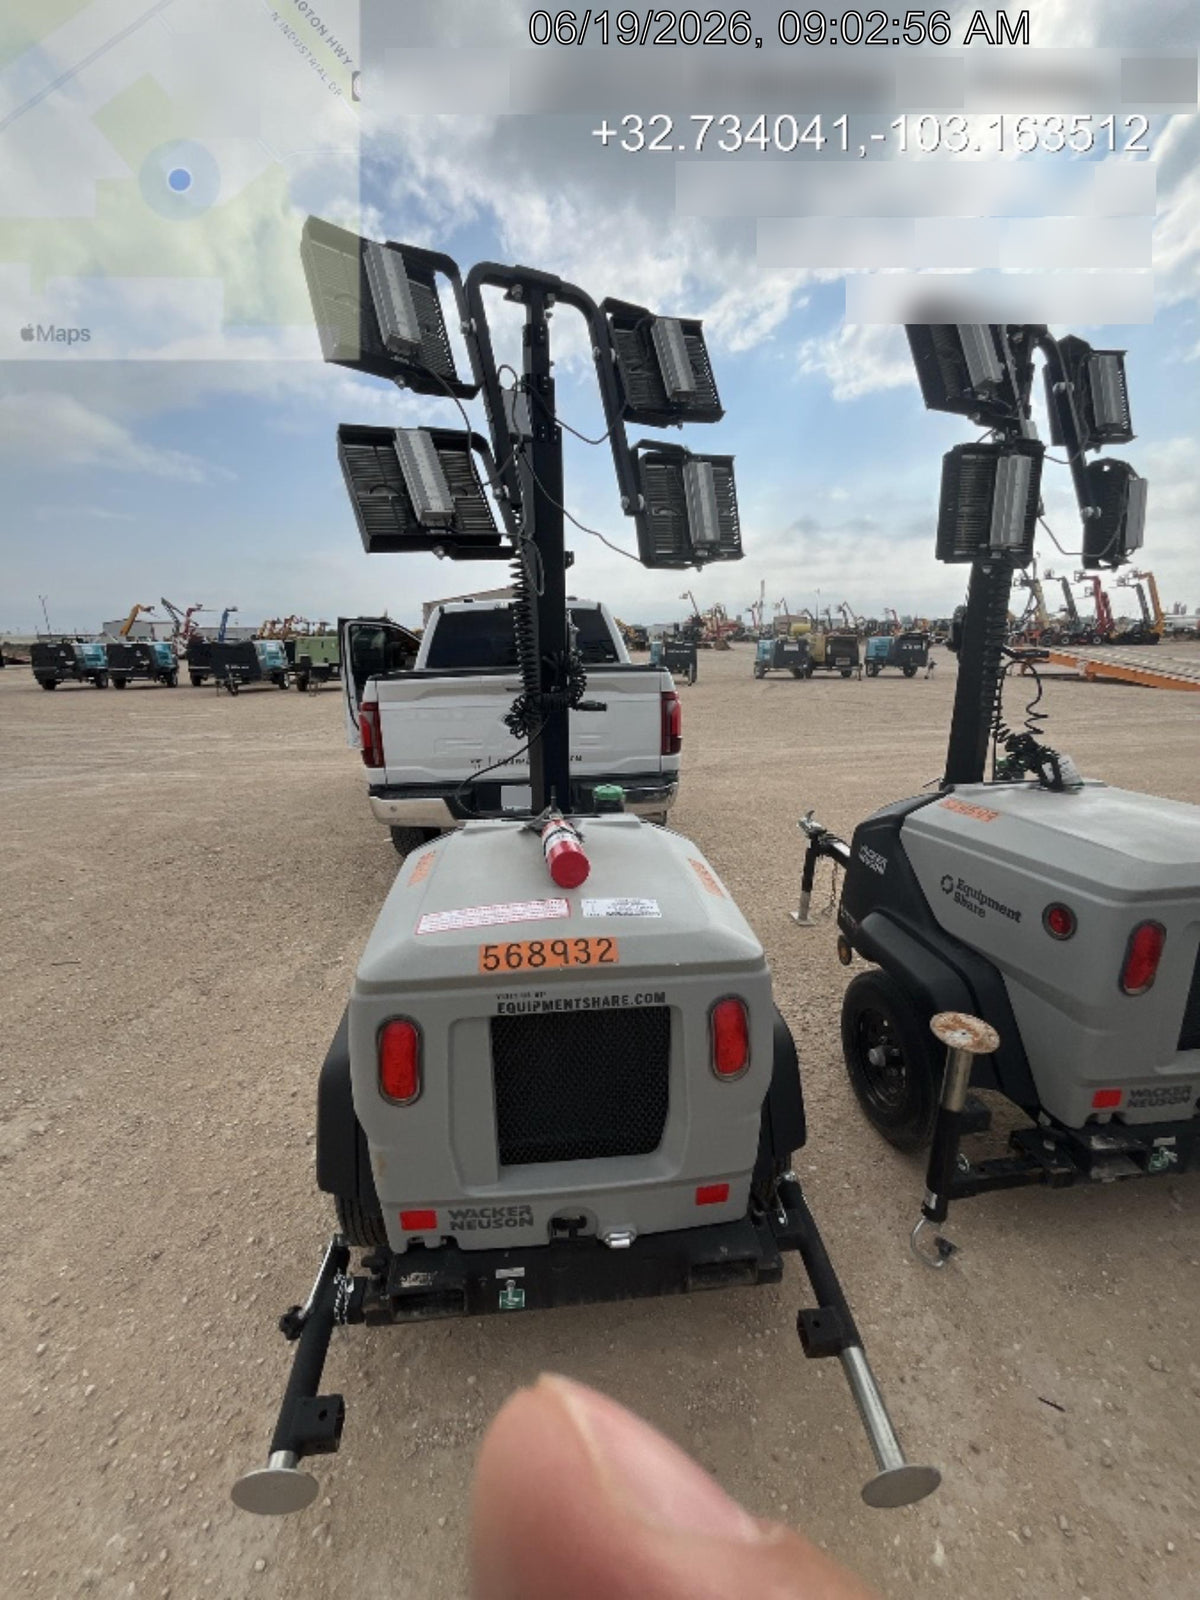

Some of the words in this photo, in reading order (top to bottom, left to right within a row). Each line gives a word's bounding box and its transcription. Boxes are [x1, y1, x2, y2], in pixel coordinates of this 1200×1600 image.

[953, 890, 986, 919] Share
[956, 877, 1022, 924] Equipment
[482, 937, 615, 971] 568932
[497, 992, 666, 1014] EQUIPMENTSHARE.COM
[447, 1205, 532, 1220] WACKER
[449, 1217, 534, 1231] NEUSON
